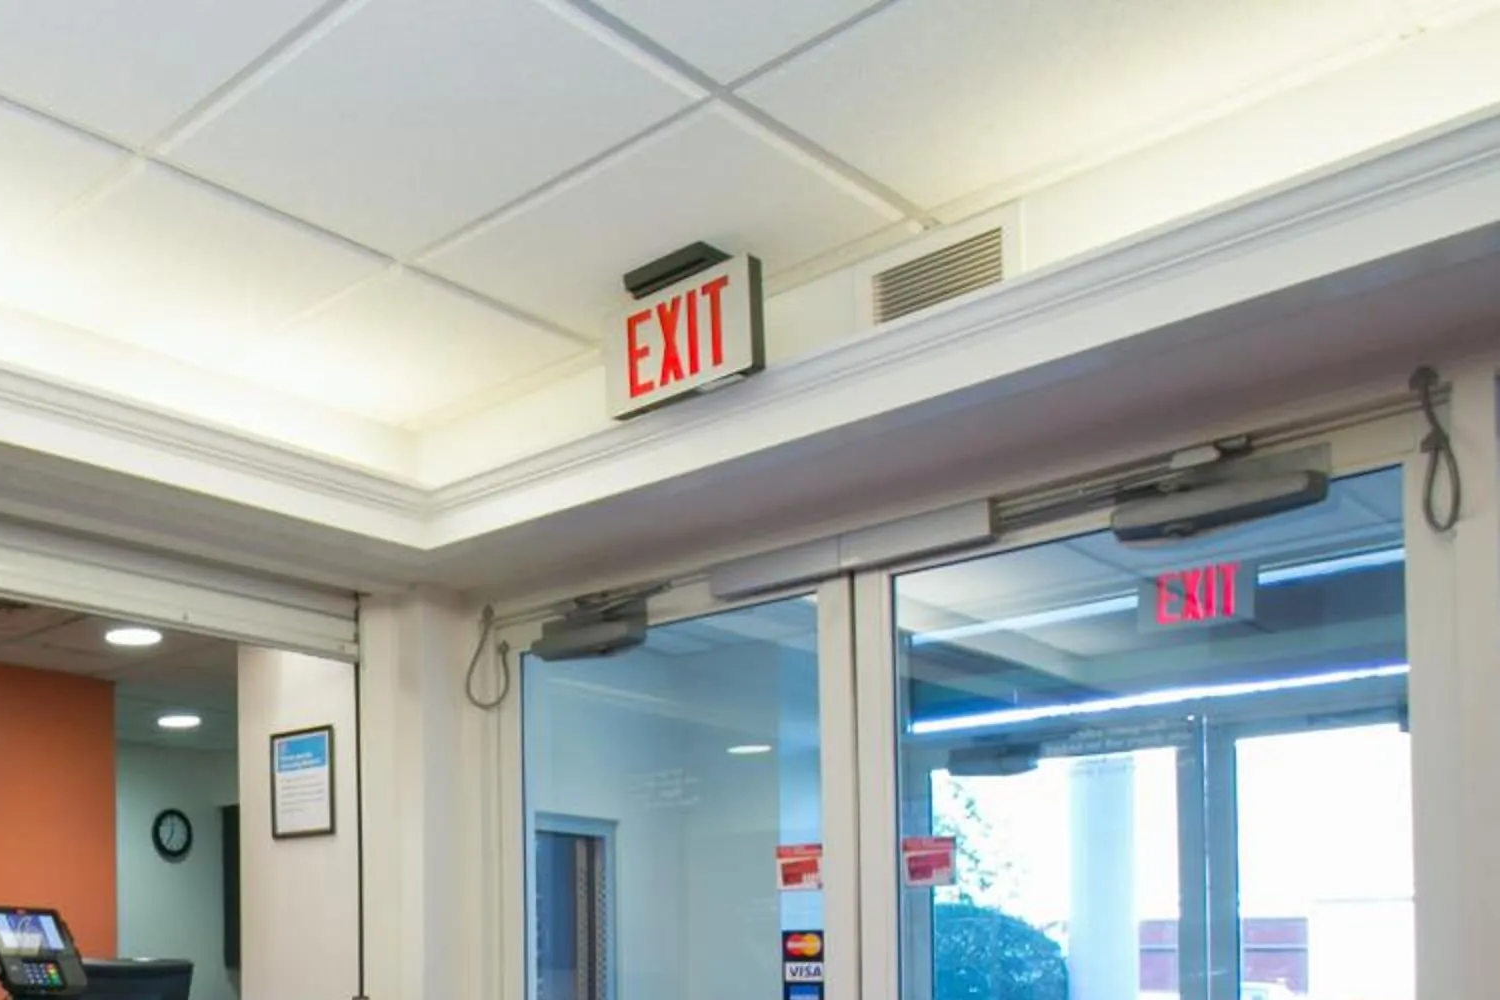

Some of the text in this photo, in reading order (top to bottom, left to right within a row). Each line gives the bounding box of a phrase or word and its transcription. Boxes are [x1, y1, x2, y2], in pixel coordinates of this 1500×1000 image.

[627, 274, 729, 398] EXIT
[1156, 561, 1239, 624] EXIT
[789, 965, 822, 978] VISA
